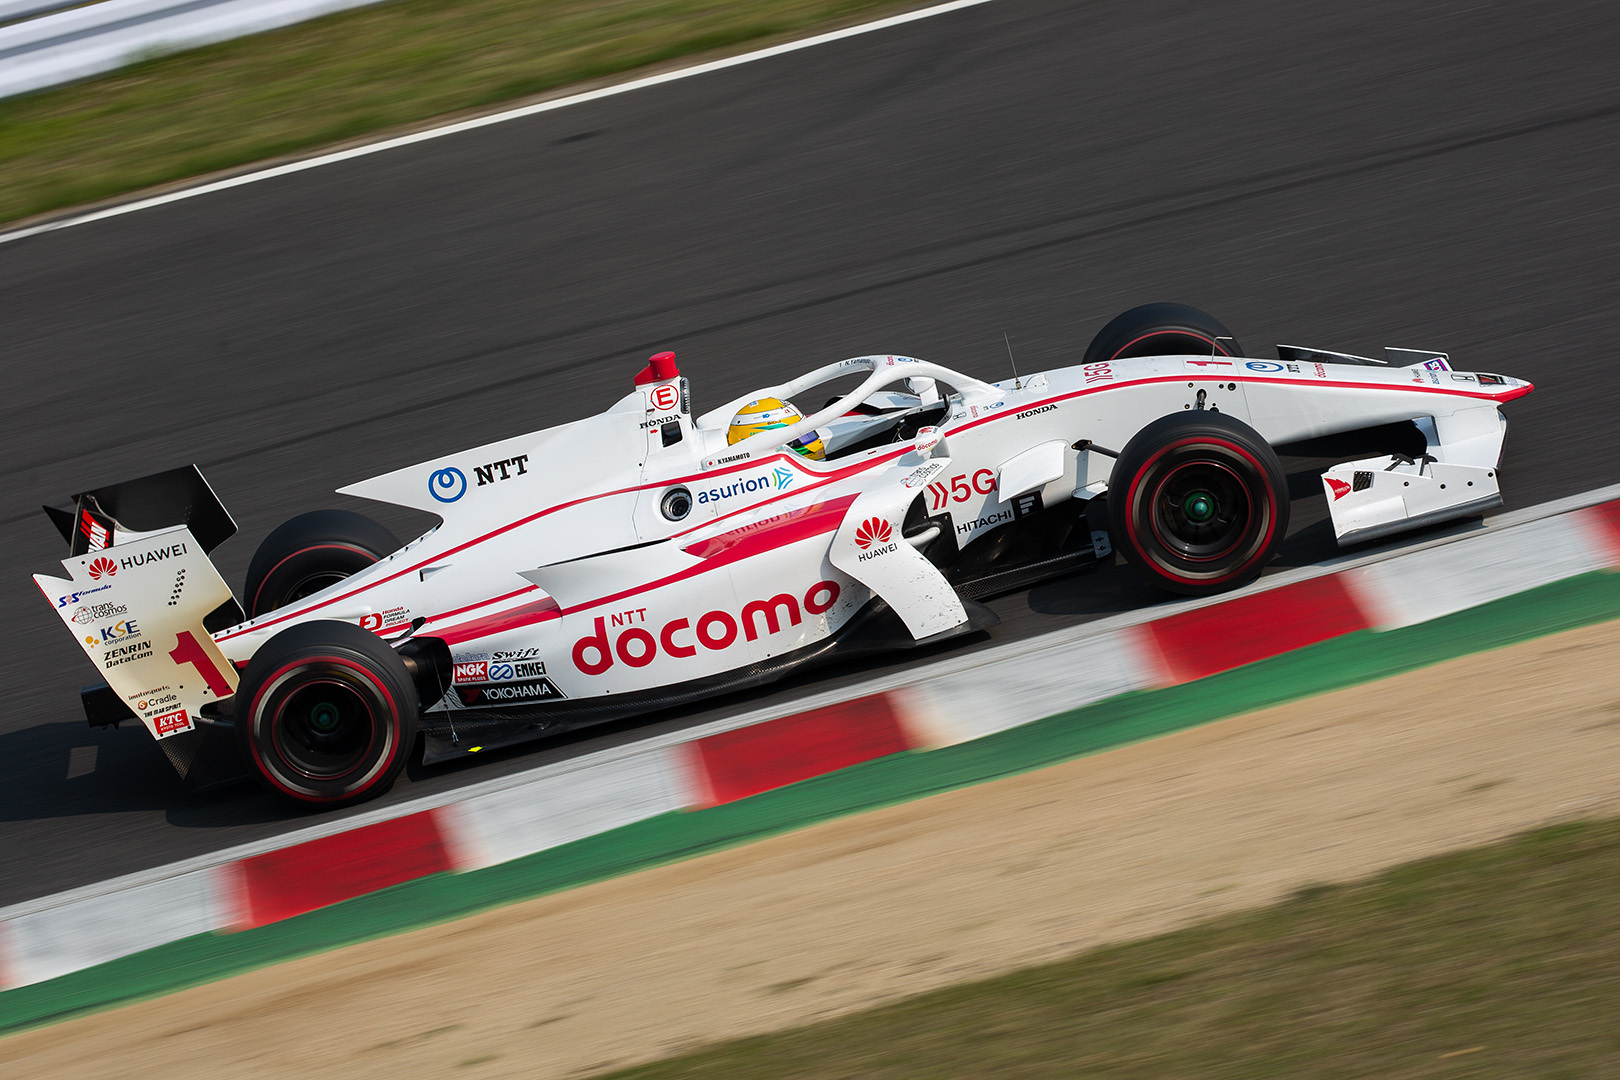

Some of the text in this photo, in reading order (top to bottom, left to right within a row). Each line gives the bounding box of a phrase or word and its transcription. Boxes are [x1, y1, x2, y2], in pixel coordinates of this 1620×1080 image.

[1016, 403, 1058, 420] HONDA
[639, 413, 682, 430] HONDA
[473, 454, 529, 486] NTT
[698, 476, 770, 504] asurion
[957, 509, 1012, 535] HITACHI
[120, 543, 188, 570] HUAWEI
[858, 542, 898, 562] HUAWEI
[91, 601, 114, 613] trans
[93, 604, 128, 619] cosmos
[611, 608, 647, 628] NTT
[101, 619, 141, 641] KSE
[572, 580, 841, 676] docomo
[104, 632, 142, 646] corporation
[104, 640, 152, 661] ZENRIN
[106, 650, 154, 669] DataCom
[492, 647, 540, 660] Swift
[168, 630, 235, 698] 1
[457, 663, 485, 677] NGK
[514, 661, 547, 678] ENKEI
[148, 694, 177, 707] Cradle
[482, 683, 552, 700] YOKOHAMA
[159, 713, 183, 728] KTC
